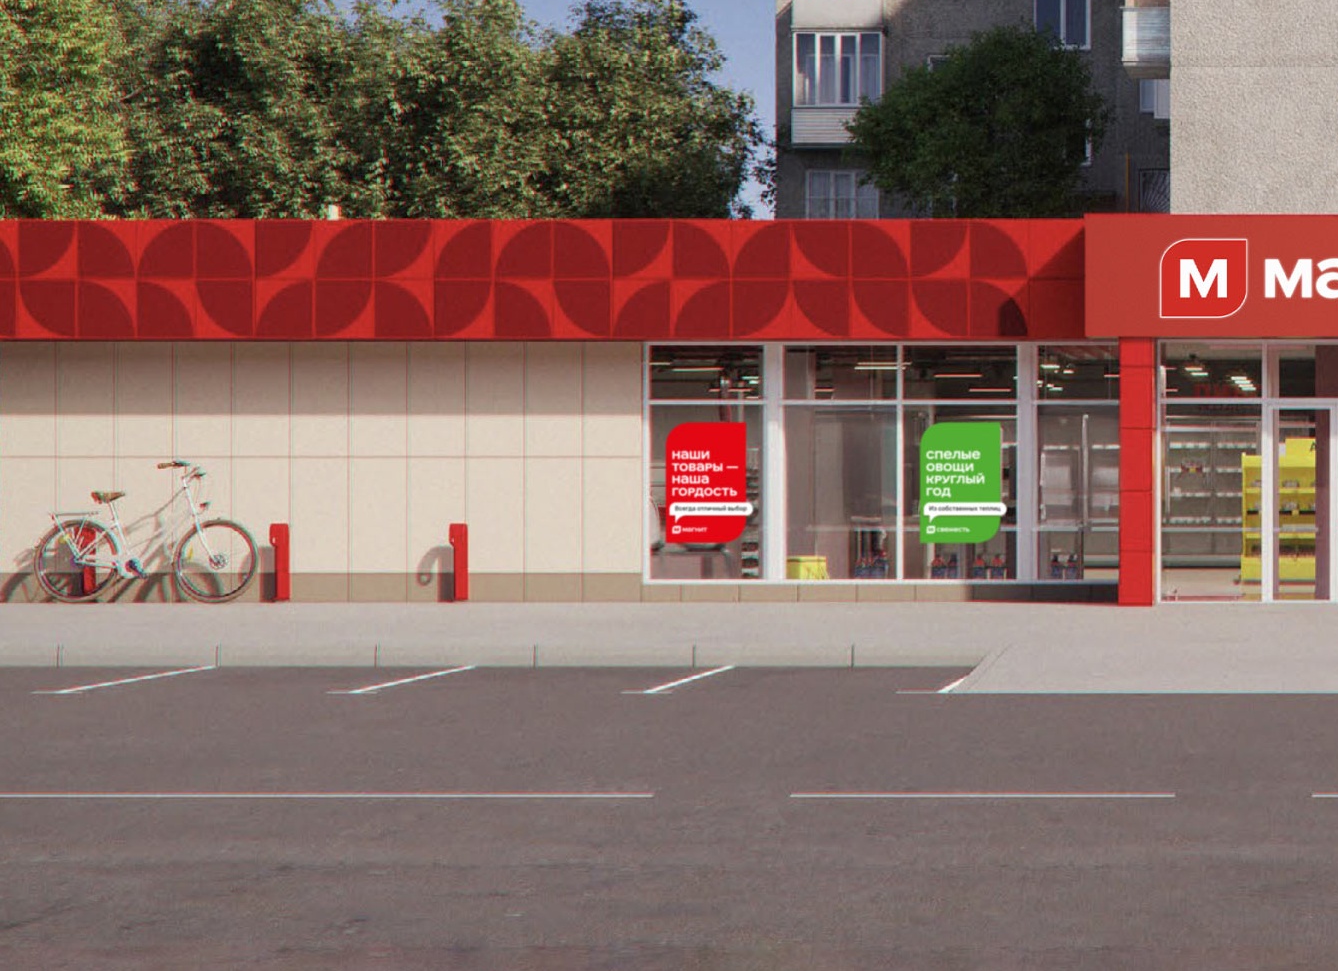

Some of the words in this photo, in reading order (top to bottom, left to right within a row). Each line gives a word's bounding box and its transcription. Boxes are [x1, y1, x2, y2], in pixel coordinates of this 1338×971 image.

[1179, 258, 1228, 298] М
[671, 450, 710, 460] наши
[925, 450, 981, 460] спелые
[671, 462, 723, 472] товары
[925, 462, 974, 472] овощи
[671, 474, 710, 484] наша
[925, 473, 985, 485] круглый
[671, 487, 738, 498] гордость
[925, 487, 952, 498] год
